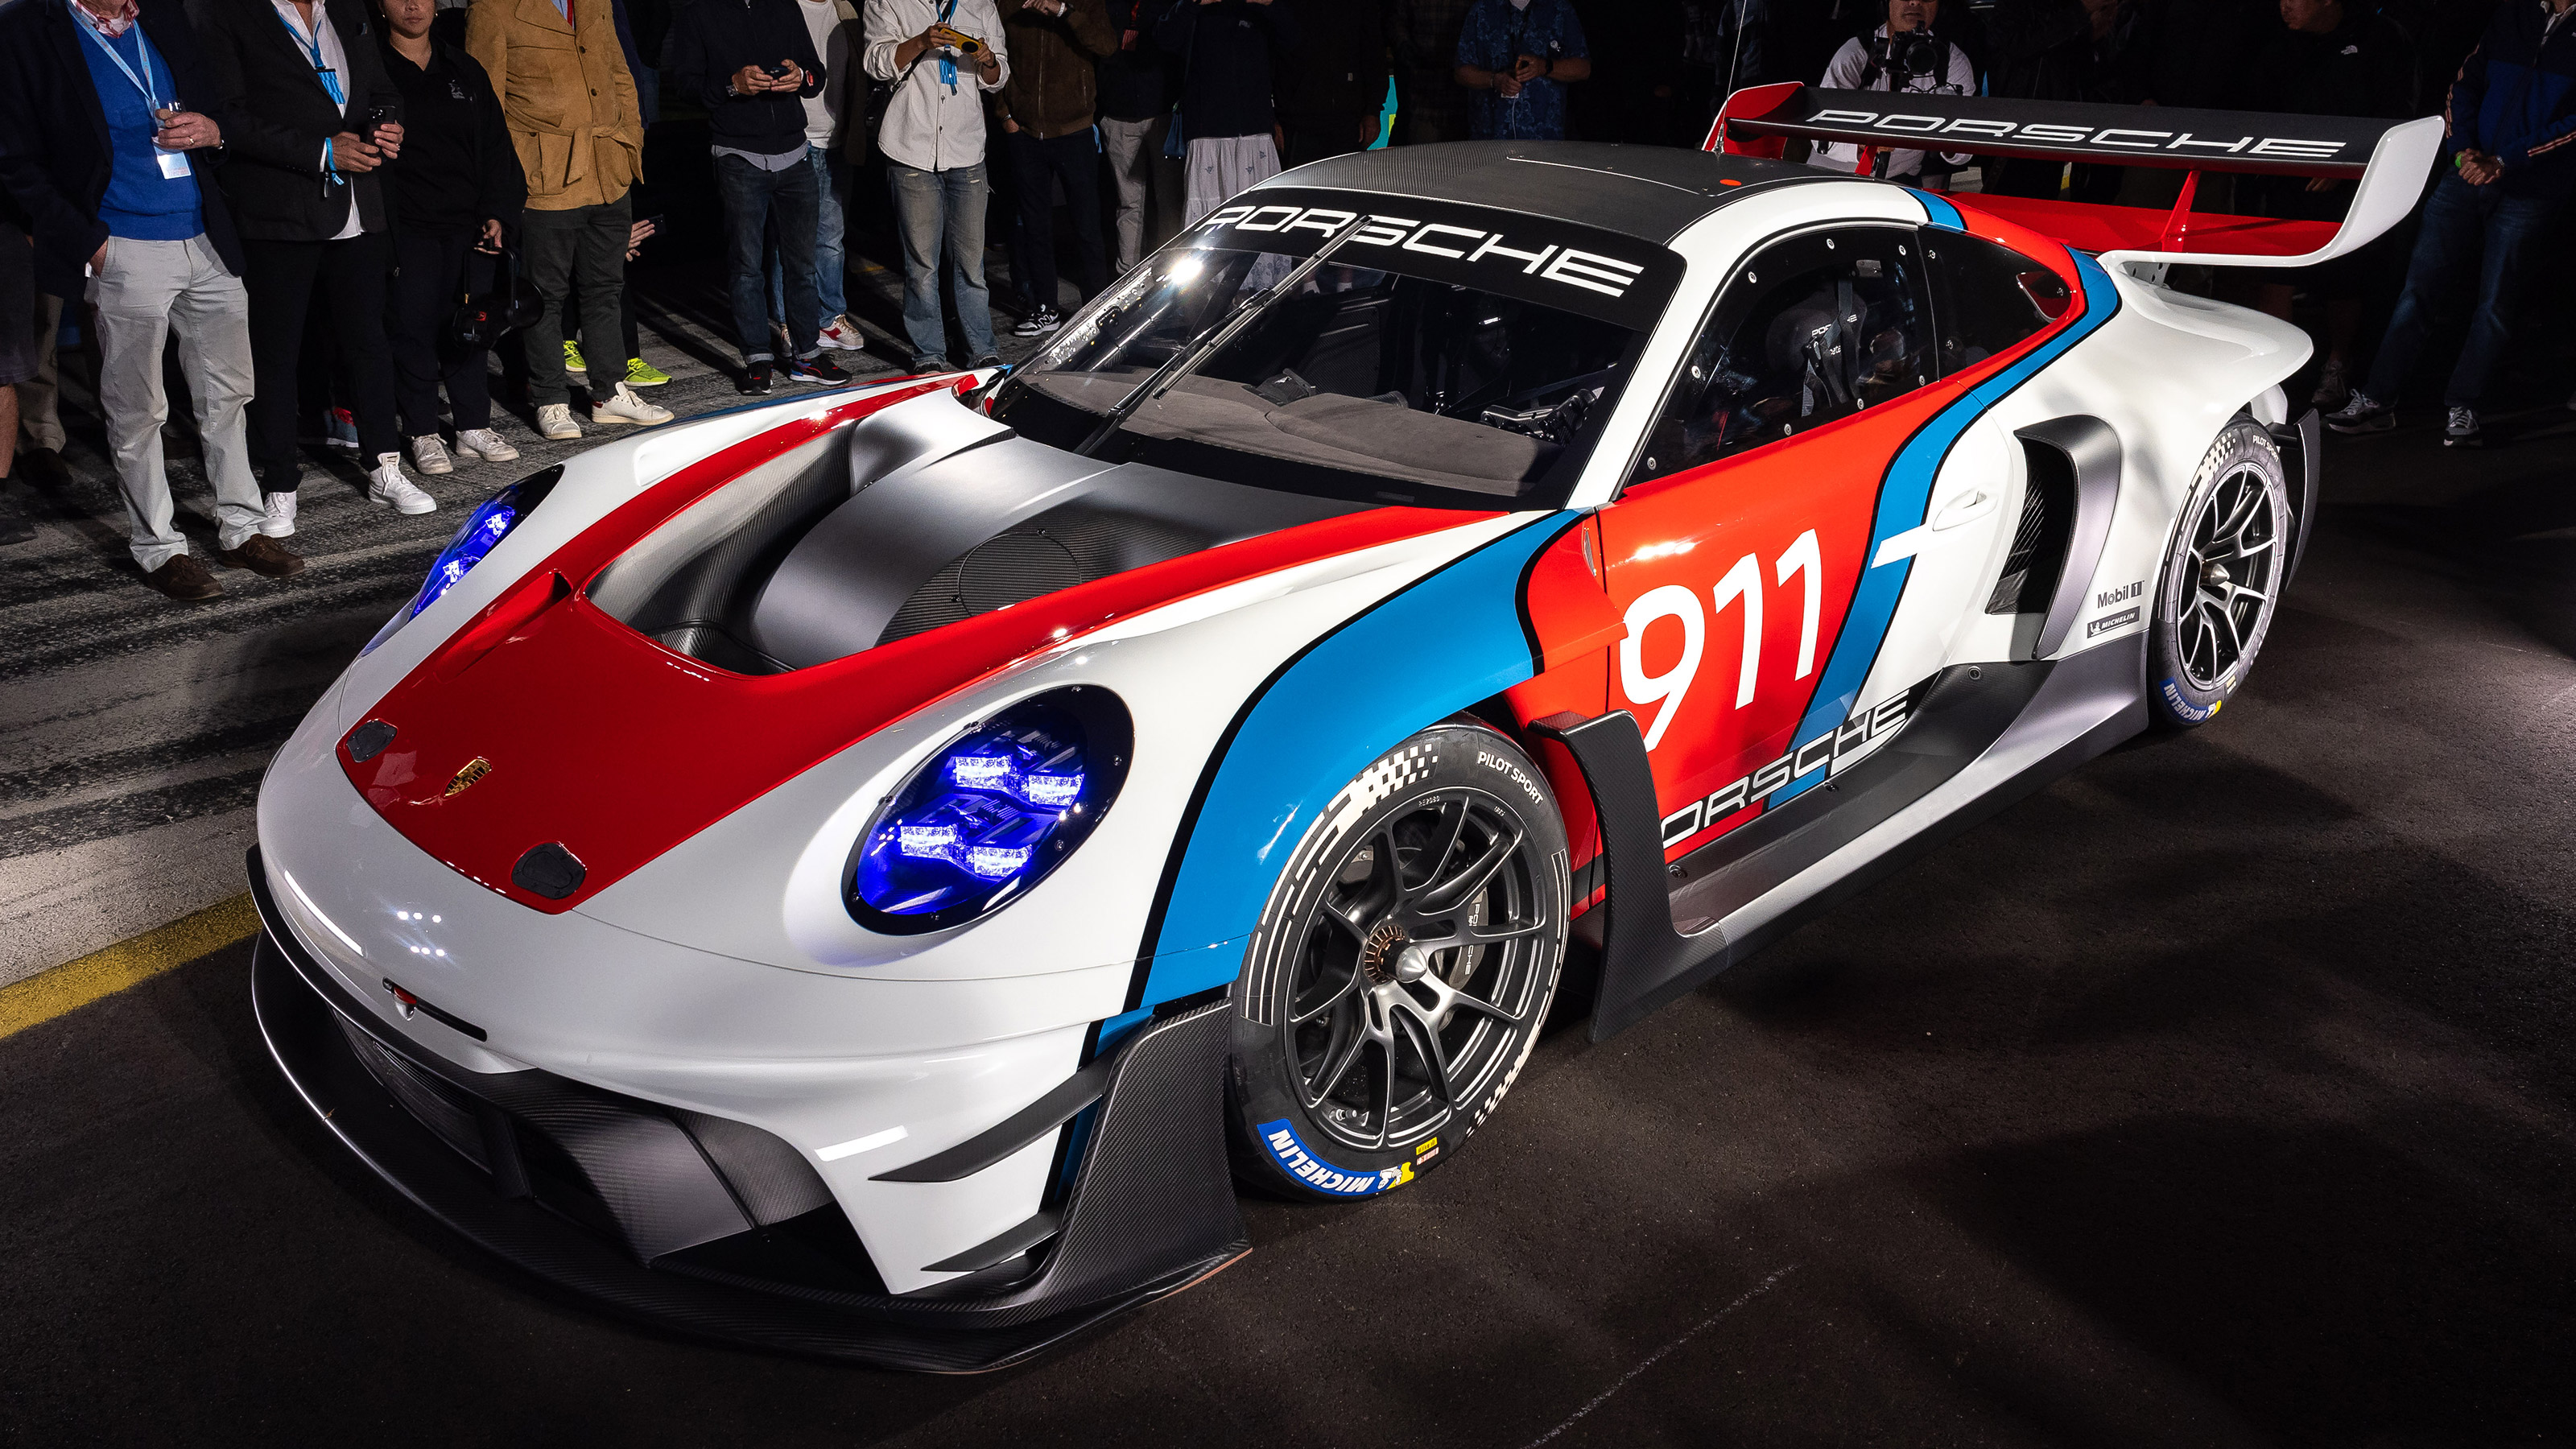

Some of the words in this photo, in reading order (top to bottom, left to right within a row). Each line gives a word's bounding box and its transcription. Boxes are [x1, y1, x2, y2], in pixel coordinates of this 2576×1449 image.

[1806, 109, 2347, 158] PORSCHE
[1205, 205, 1645, 299] PORSCHE
[2252, 435, 2267, 448] PILOT
[2097, 584, 2129, 609] Mobil
[2100, 612, 2136, 630] MICHELIN
[1619, 527, 1823, 753] 911
[2163, 682, 2207, 721] MICHELIN
[1476, 750, 1513, 774] PILOT
[1510, 767, 1544, 805] SPORT
[1660, 689, 1910, 849] ORSCHE
[1464, 903, 1480, 976] POCHE
[1267, 1129, 1376, 1193] MICHELIN
